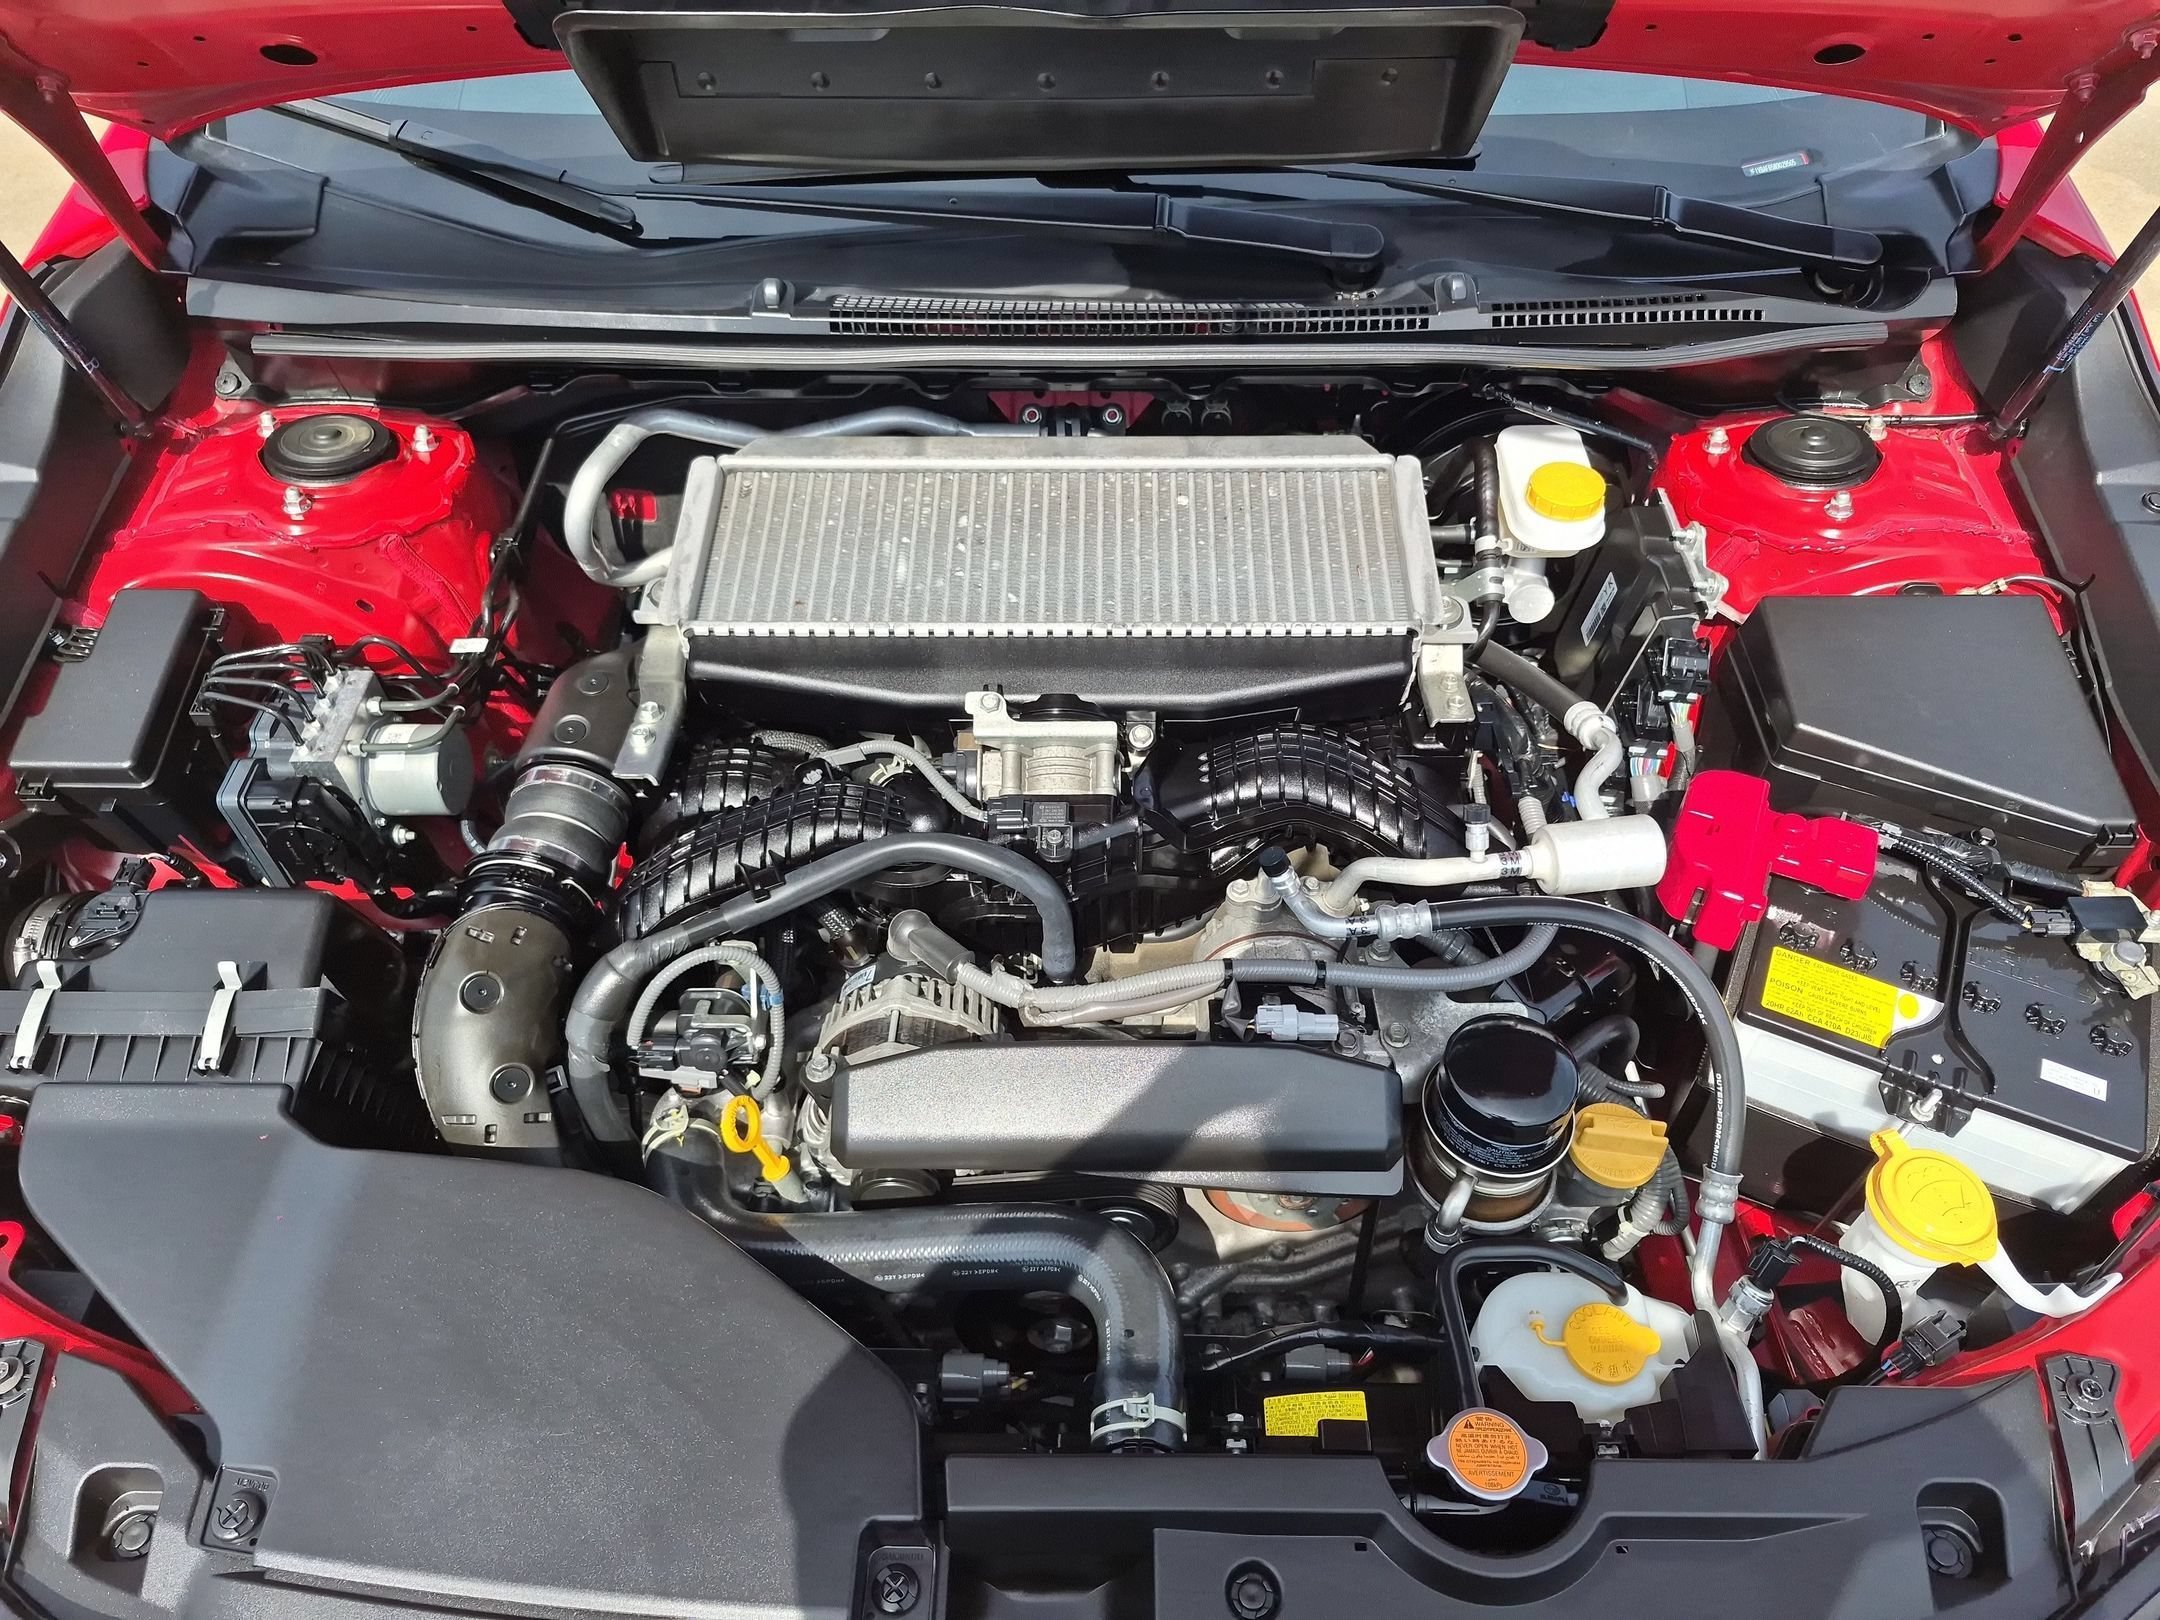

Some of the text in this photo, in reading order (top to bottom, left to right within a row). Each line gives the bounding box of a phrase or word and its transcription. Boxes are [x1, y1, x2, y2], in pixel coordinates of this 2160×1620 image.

[1775, 949, 1811, 966] DANGER
[1769, 978, 1804, 995] POISON
[1765, 1000, 1785, 1011] 20HR
[1807, 1014, 1824, 1025] CCA
[1824, 1020, 1842, 1032] 470A
[1806, 1005, 1817, 1014] OUT
[1825, 1011, 1843, 1023] REACH
[1851, 1019, 1877, 1035] CHILDREN
[1486, 1146, 1518, 1156] CAUTION
[1569, 1305, 1632, 1330] COOLANT
